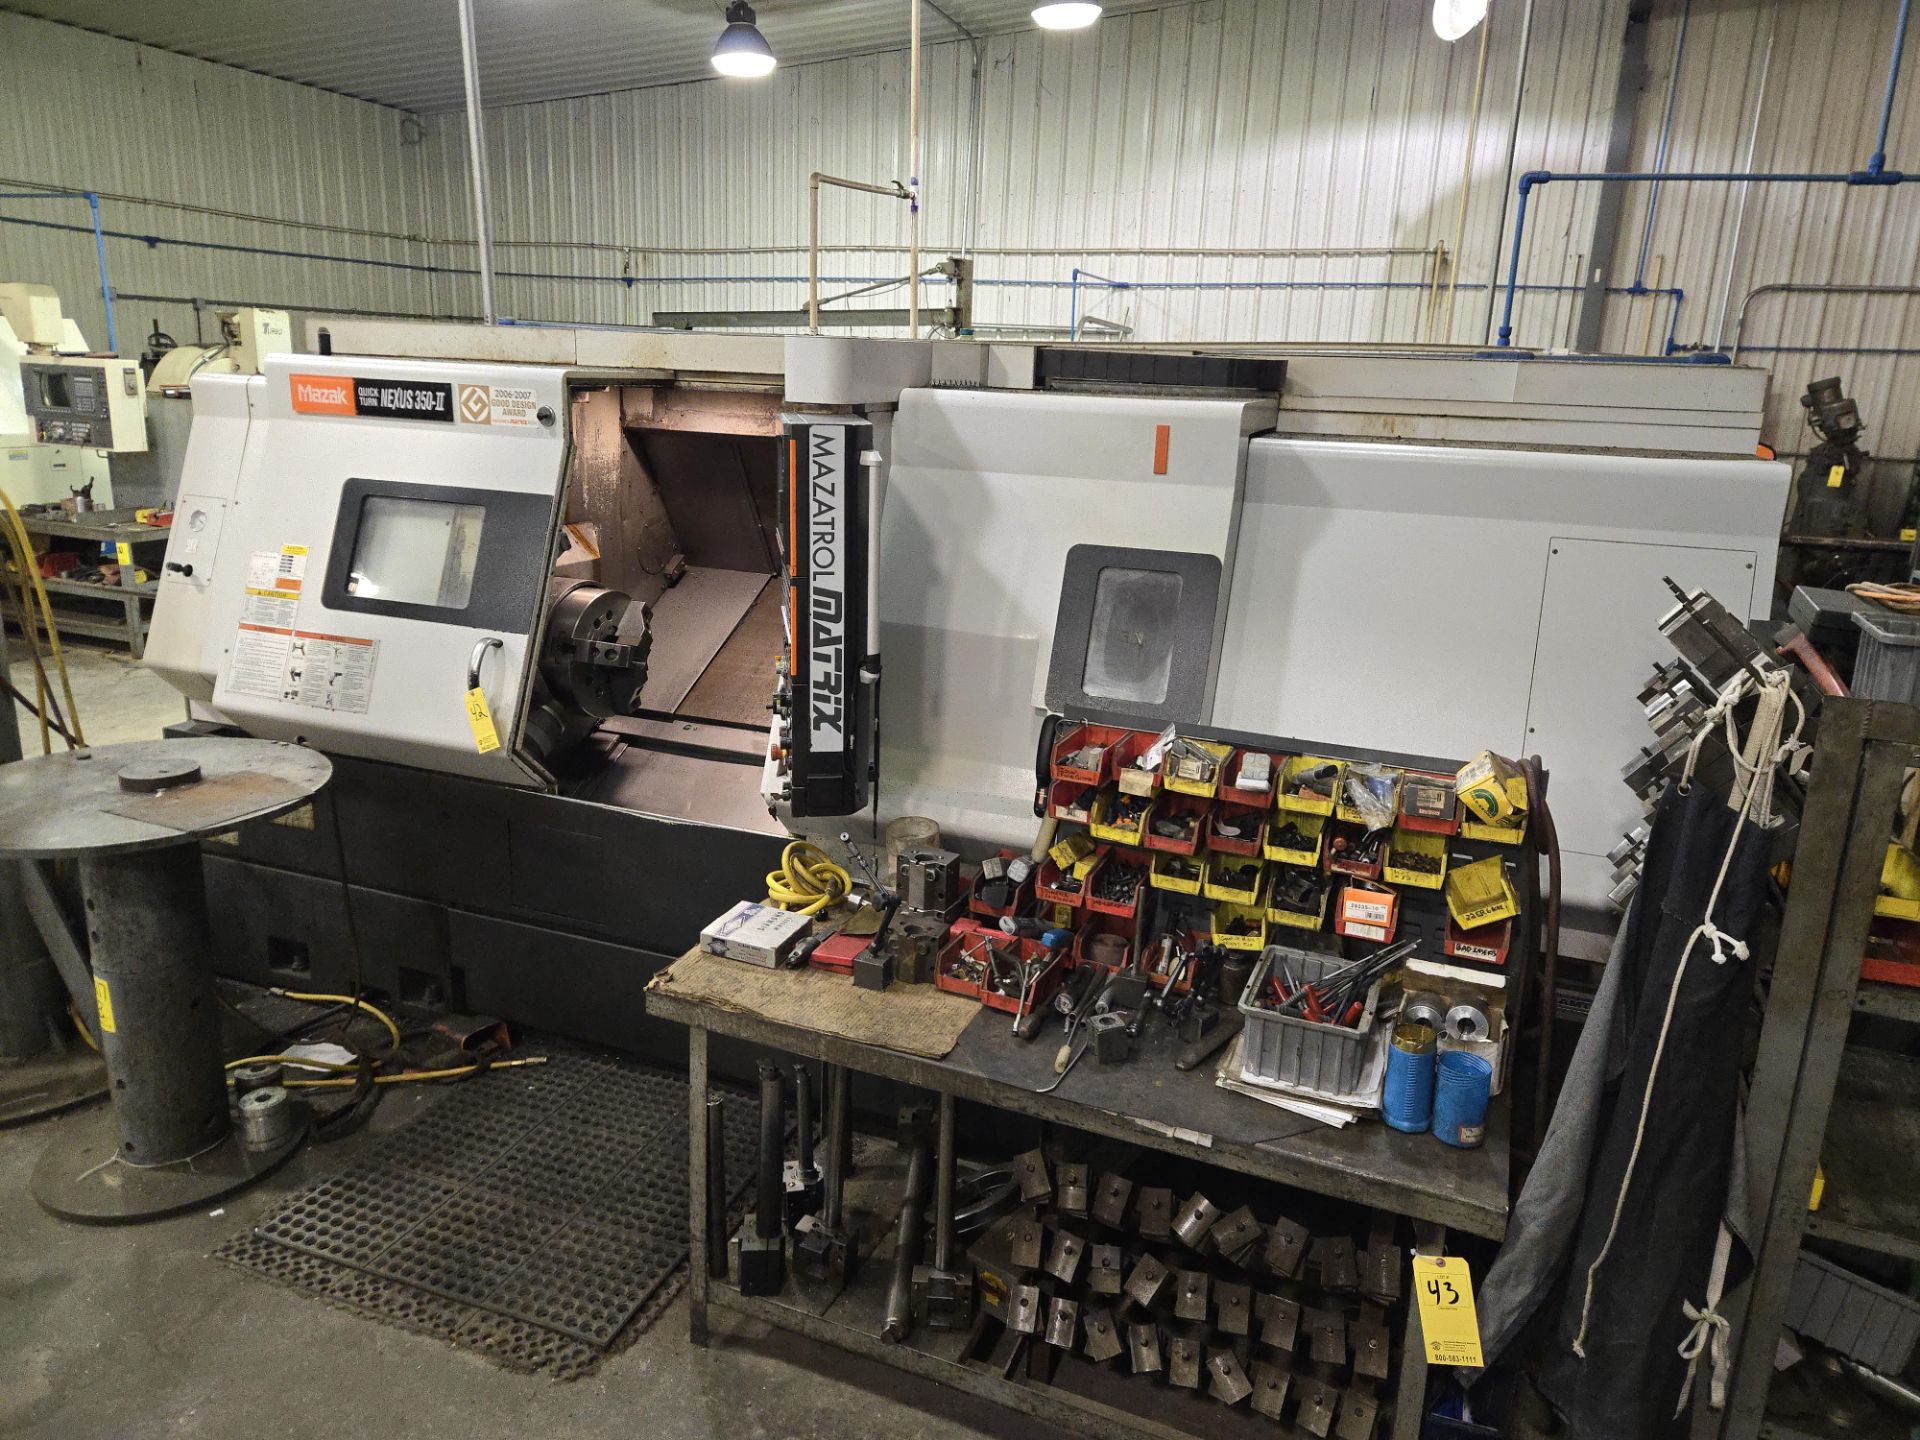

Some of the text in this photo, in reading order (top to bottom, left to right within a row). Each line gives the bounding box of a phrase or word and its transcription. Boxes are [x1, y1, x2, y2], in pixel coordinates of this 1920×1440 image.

[297, 384, 349, 404] Mazak
[358, 386, 380, 397] QUICK
[360, 397, 378, 407] TURN
[380, 387, 446, 412] NEXUS 350-II
[491, 399, 537, 410] GOOD DESIGN
[502, 408, 527, 418] AWARD
[812, 433, 836, 582] MAZATROL
[1455, 943, 1472, 953] BAD
[1427, 1280, 1459, 1305] 43
